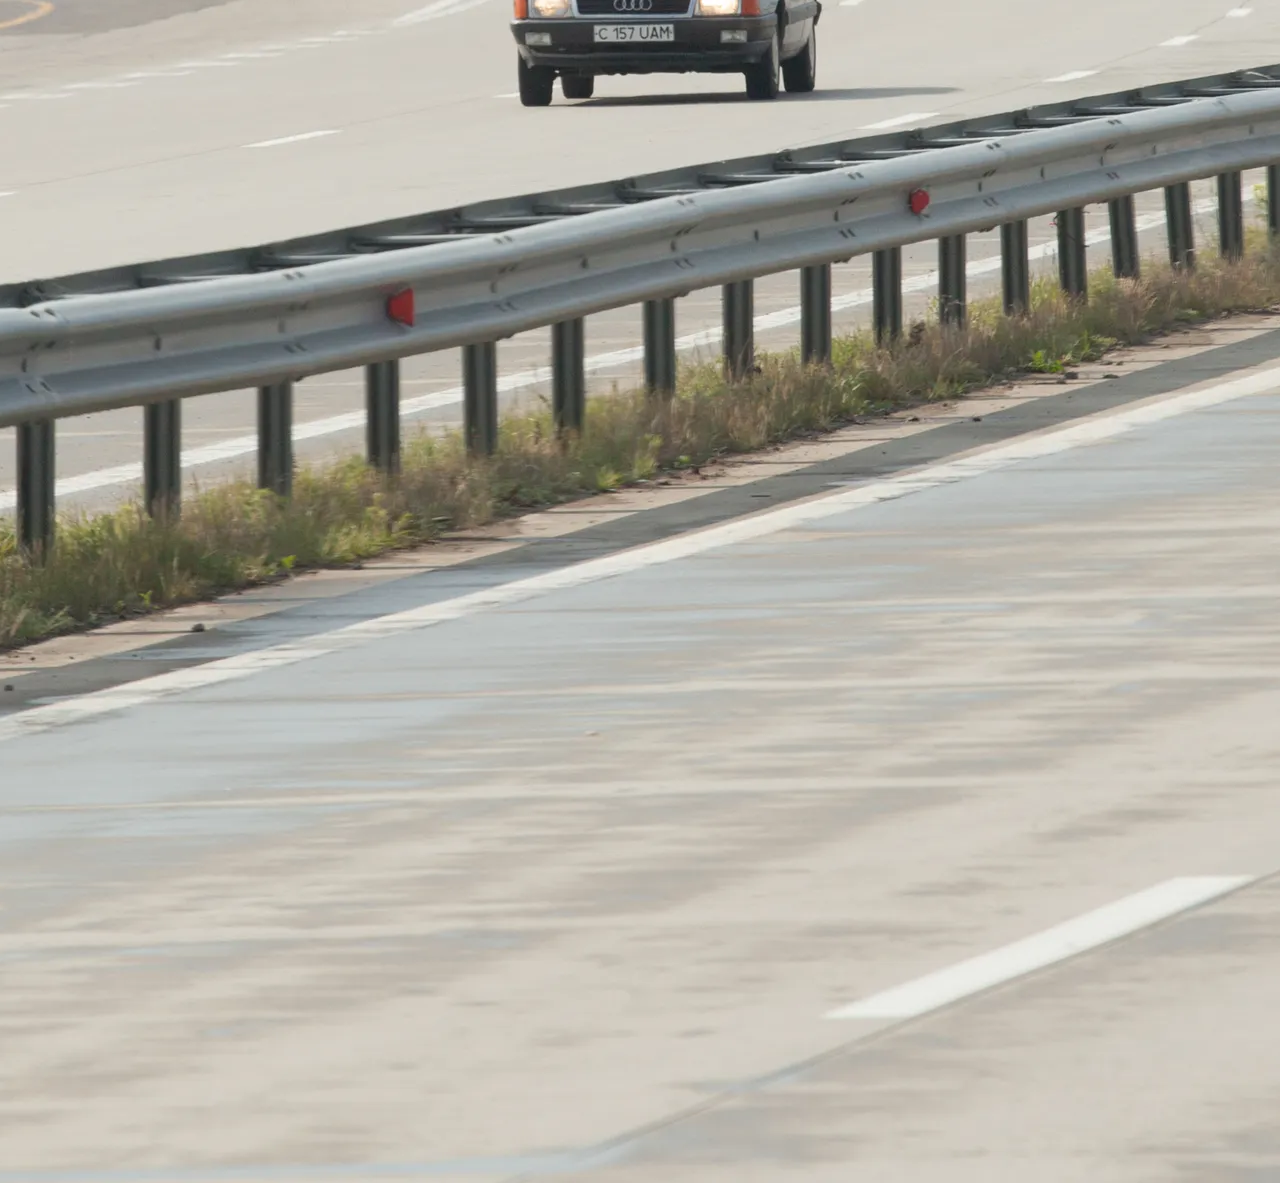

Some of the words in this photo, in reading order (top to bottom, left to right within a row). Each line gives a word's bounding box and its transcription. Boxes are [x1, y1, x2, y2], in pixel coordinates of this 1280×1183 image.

[598, 27, 608, 40] C
[612, 26, 635, 40] 157
[639, 26, 670, 40] UAM
